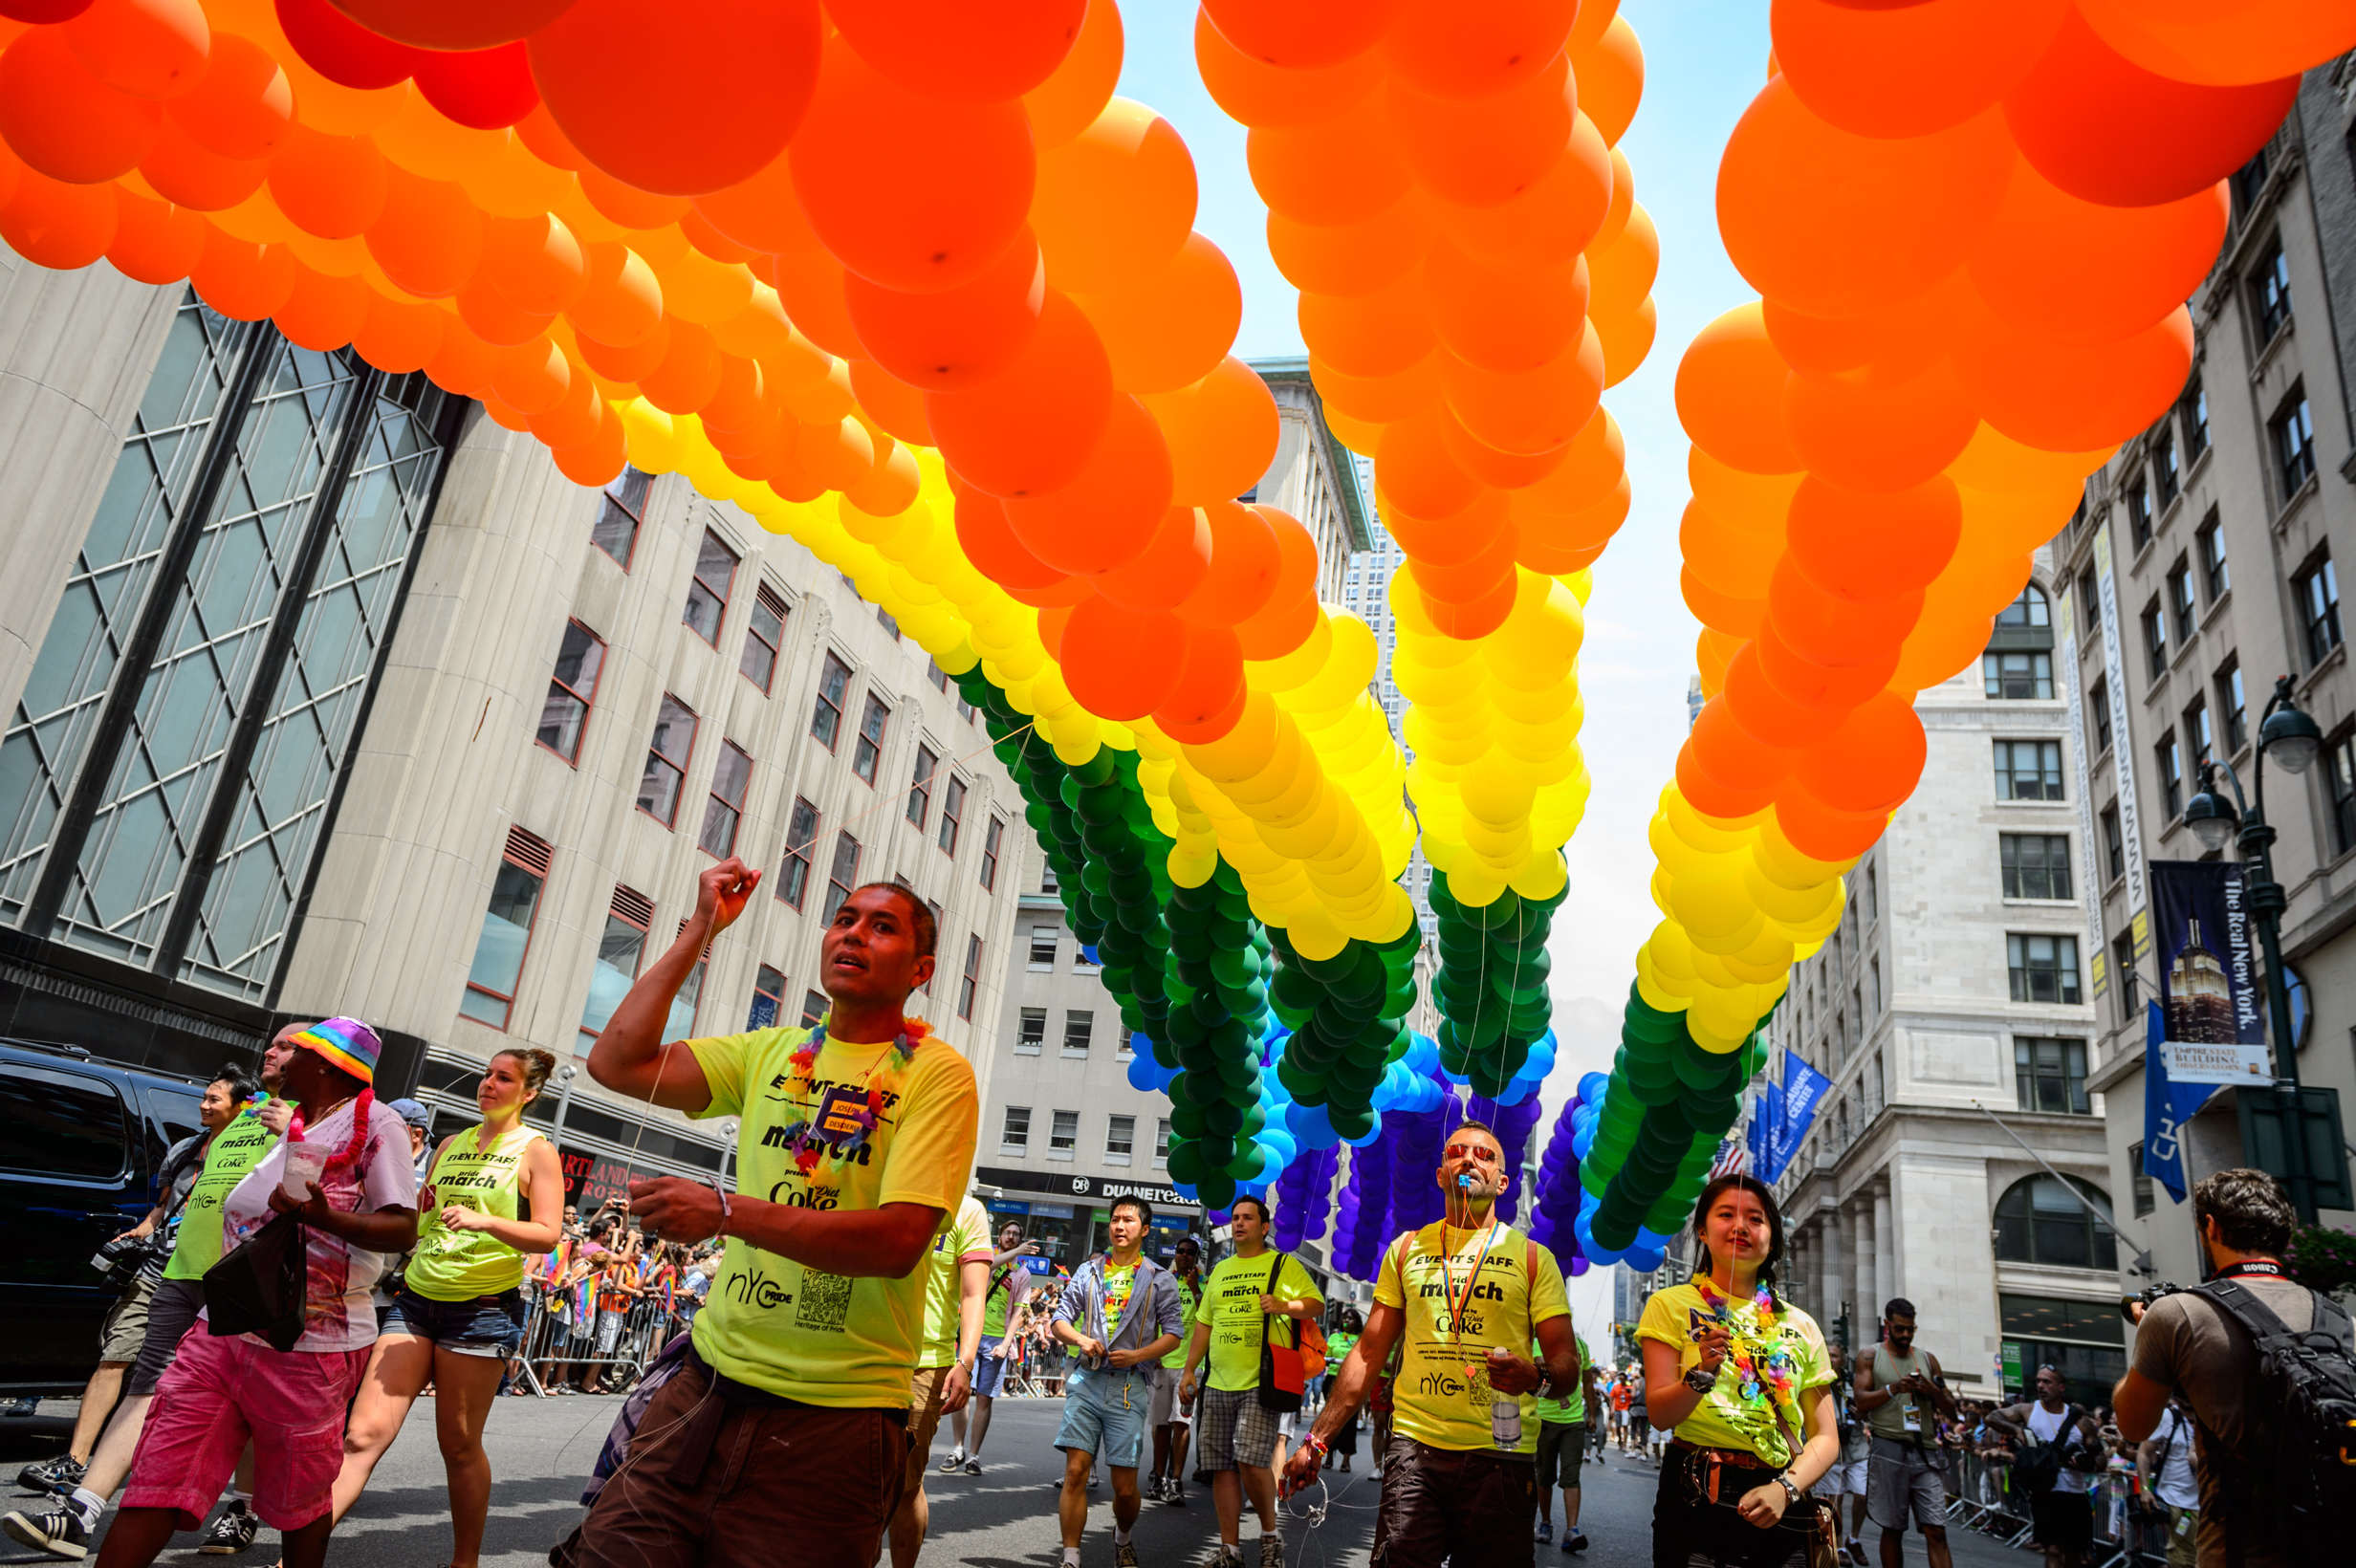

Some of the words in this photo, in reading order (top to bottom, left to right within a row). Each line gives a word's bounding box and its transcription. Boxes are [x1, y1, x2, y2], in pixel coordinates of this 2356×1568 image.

[2104, 576, 2142, 903] www.wework.com
[2224, 879, 2243, 909] The
[2227, 911, 2249, 948] Real
[2231, 950, 2251, 985] New
[2236, 987, 2258, 1031] York.
[2175, 1055, 2239, 1064] BUILDING
[1788, 1084, 1815, 1120] CENTER
[219, 1134, 267, 1149] march
[216, 1157, 248, 1168] Coke
[436, 1175, 497, 1189] march
[769, 1181, 839, 1211] Coke
[815, 1185, 840, 1198] Diet
[1466, 1254, 1515, 1268] SAFF
[2242, 1263, 2279, 1274] Canon
[726, 1267, 781, 1309] nYC
[1222, 1286, 1260, 1297] march
[764, 1290, 794, 1304] PRIDE
[1229, 1305, 1252, 1314] Coke
[1465, 1314, 1484, 1322] Diet
[795, 1319, 820, 1332] Heritage
[829, 1325, 846, 1334] Pride
[1420, 1372, 1456, 1397] nYC
